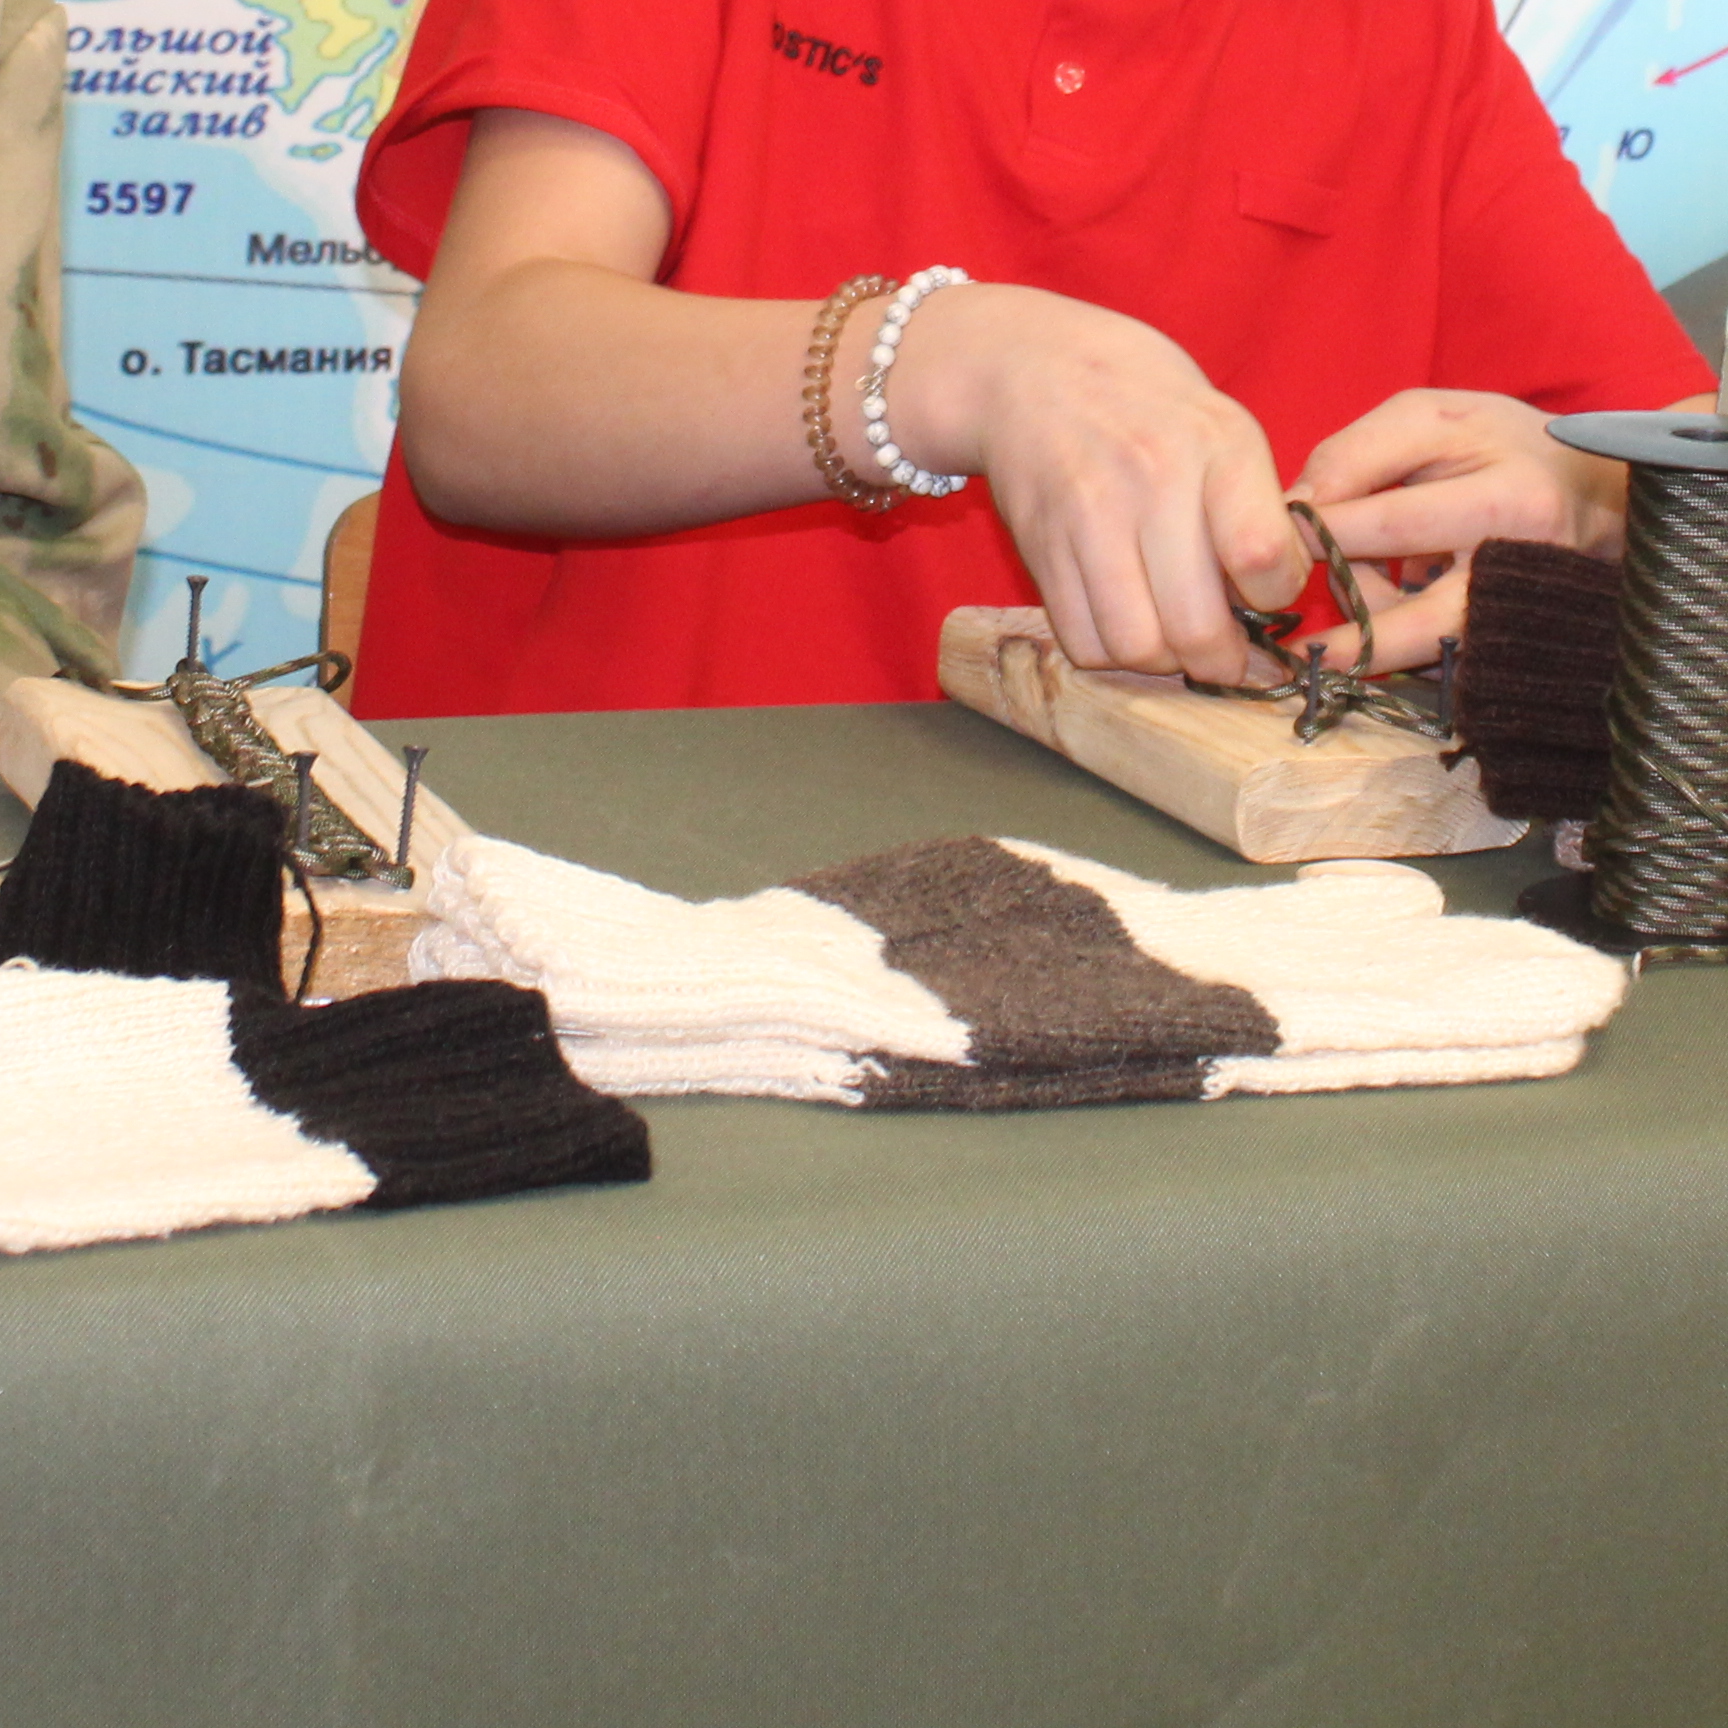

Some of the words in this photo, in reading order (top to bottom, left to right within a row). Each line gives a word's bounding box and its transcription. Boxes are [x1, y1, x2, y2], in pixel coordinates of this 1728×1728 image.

[66, 19, 273, 56] ольшой
[63, 61, 273, 96] ийский
[112, 105, 271, 140] залив
[86, 181, 196, 215] 5597
[245, 232, 389, 268] Мельб
[178, 340, 393, 376] Тасмания
